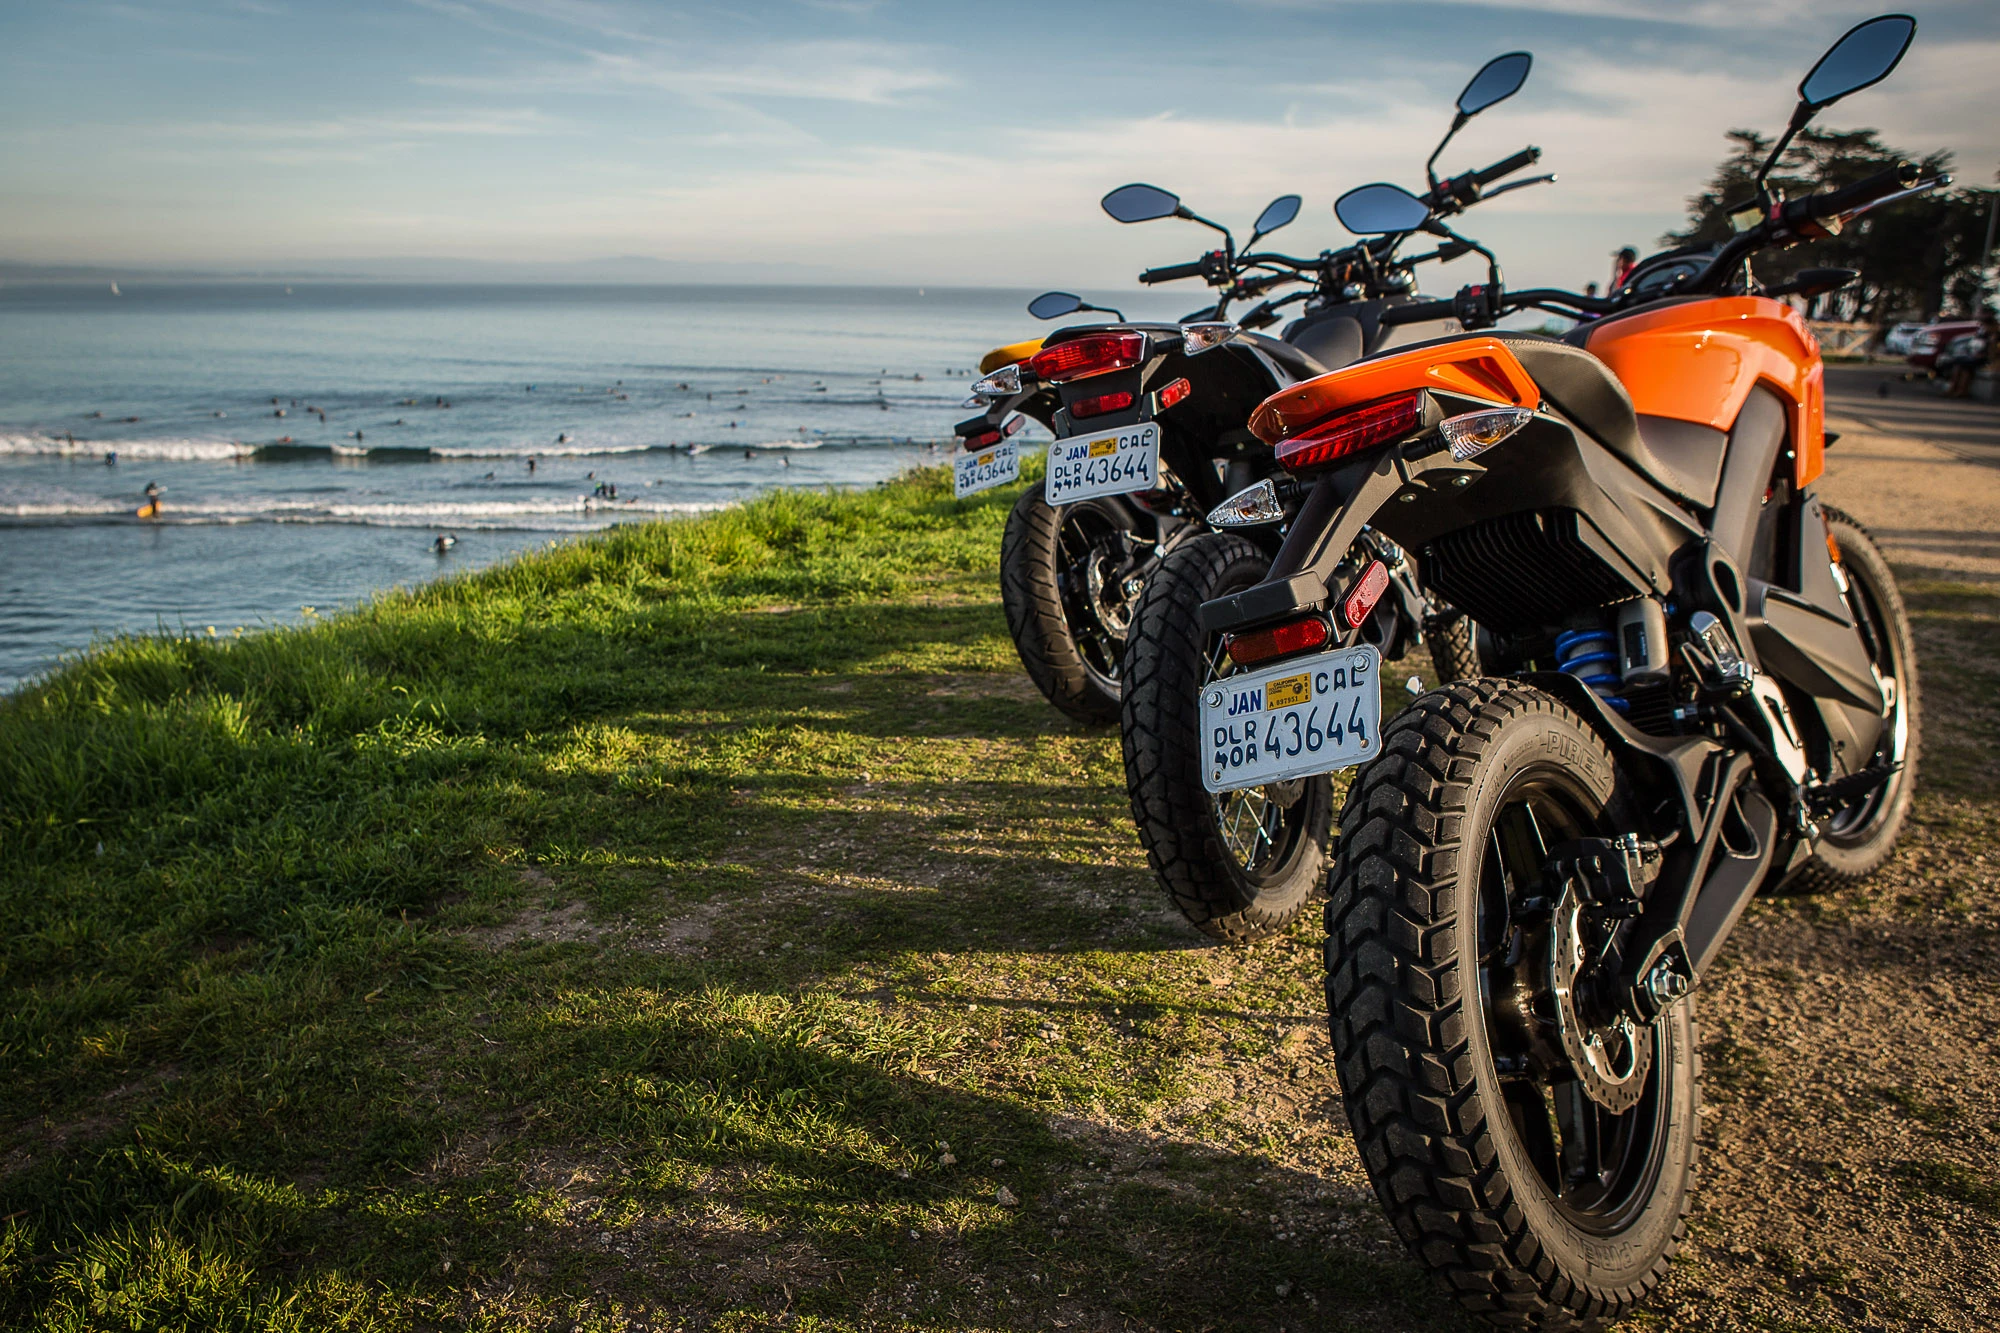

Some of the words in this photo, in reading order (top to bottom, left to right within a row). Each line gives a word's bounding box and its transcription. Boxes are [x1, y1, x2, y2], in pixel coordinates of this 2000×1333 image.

[1066, 445, 1088, 461] JAN
[1120, 435, 1150, 449] CAL
[977, 458, 1014, 482] 43644
[1055, 463, 1082, 479] DLR
[1085, 452, 1149, 486] 43644
[1315, 667, 1365, 694] CAL
[1228, 689, 1262, 716] JAN
[1214, 720, 1257, 748] DLR
[1264, 696, 1365, 759] 43644
[1215, 743, 1258, 769] 40A
[1547, 730, 1613, 796] PIREL
